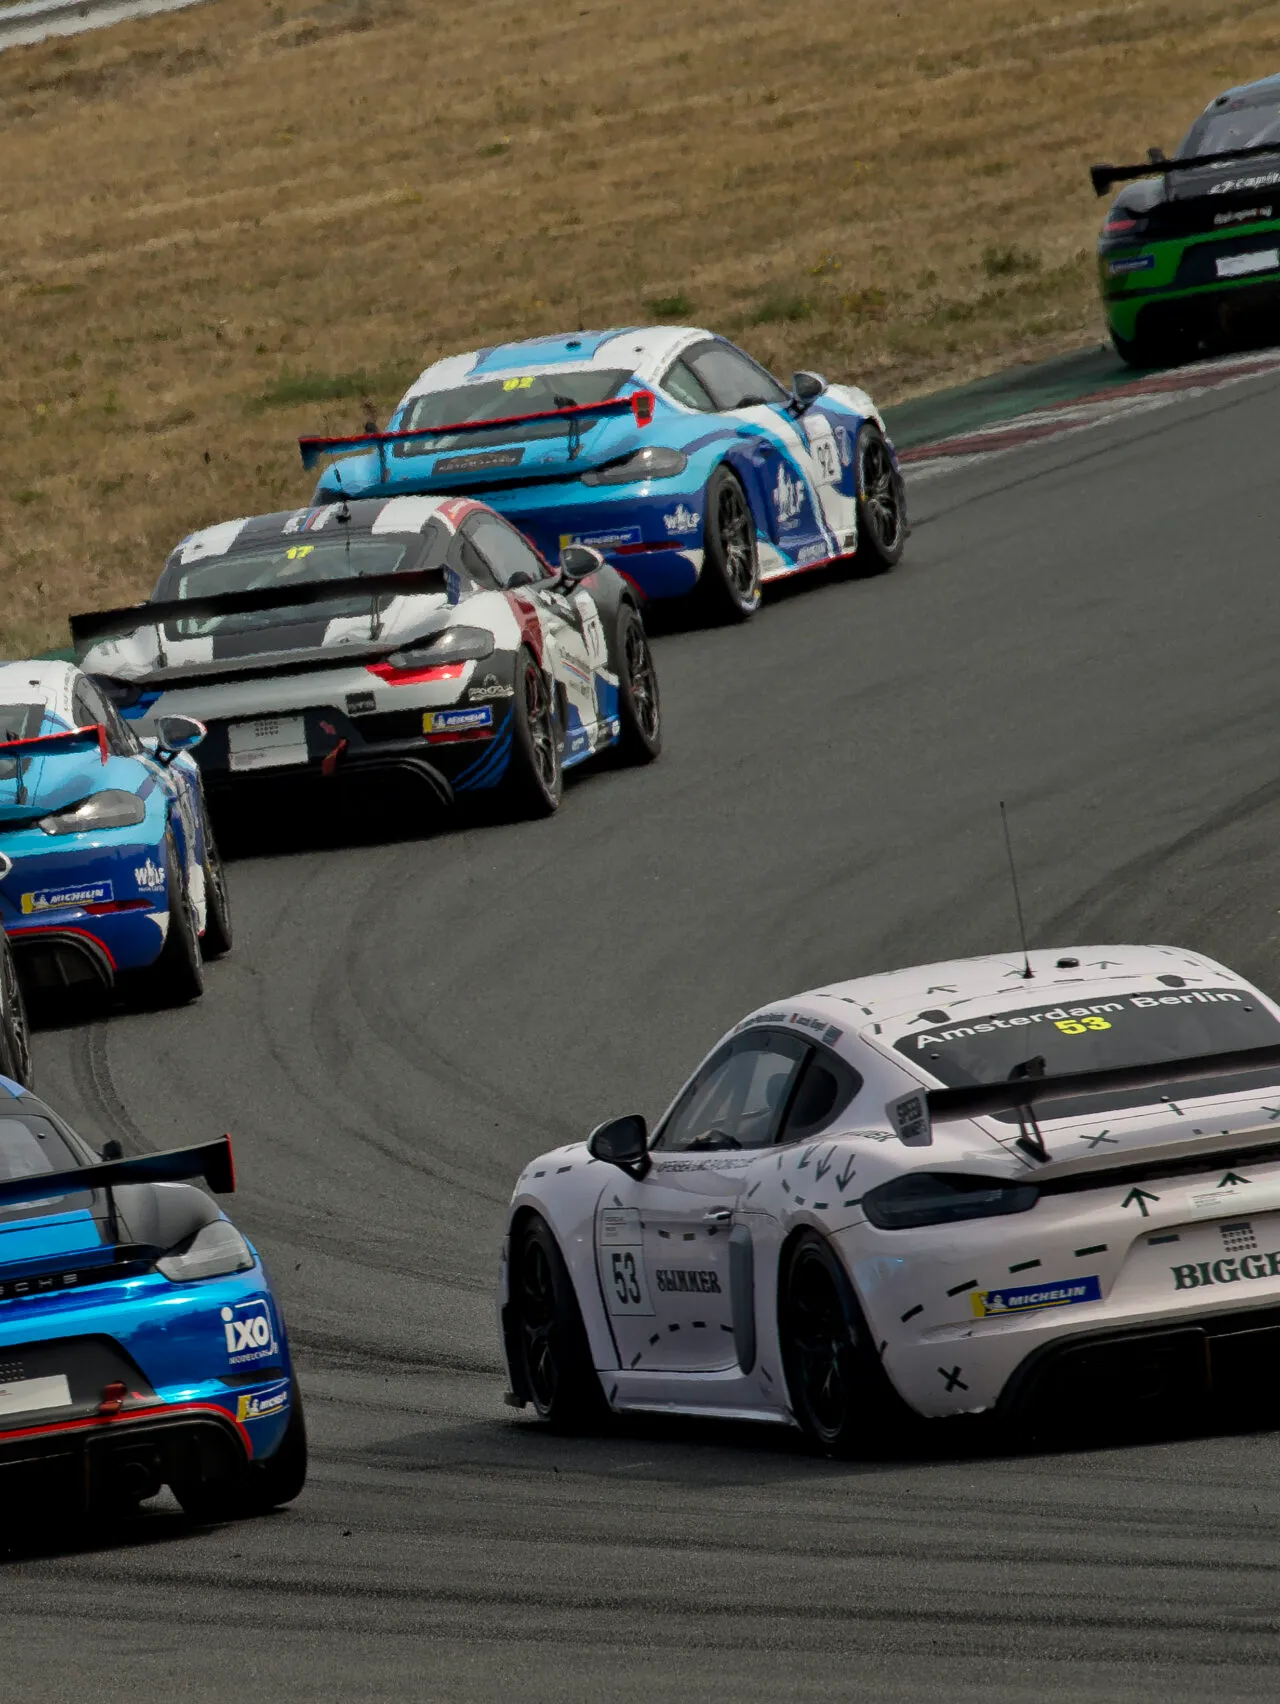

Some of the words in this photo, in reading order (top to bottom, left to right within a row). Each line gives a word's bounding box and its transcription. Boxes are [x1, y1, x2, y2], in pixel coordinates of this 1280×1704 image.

[286, 545, 315, 560] 17
[50, 888, 105, 904] MICHELIN
[917, 1000, 1125, 1049] Amsterdam
[1129, 990, 1243, 1010] Berlin
[1054, 1016, 1112, 1036] 53
[612, 1252, 641, 1304] 53
[1008, 1286, 1087, 1307] MICHELIN
